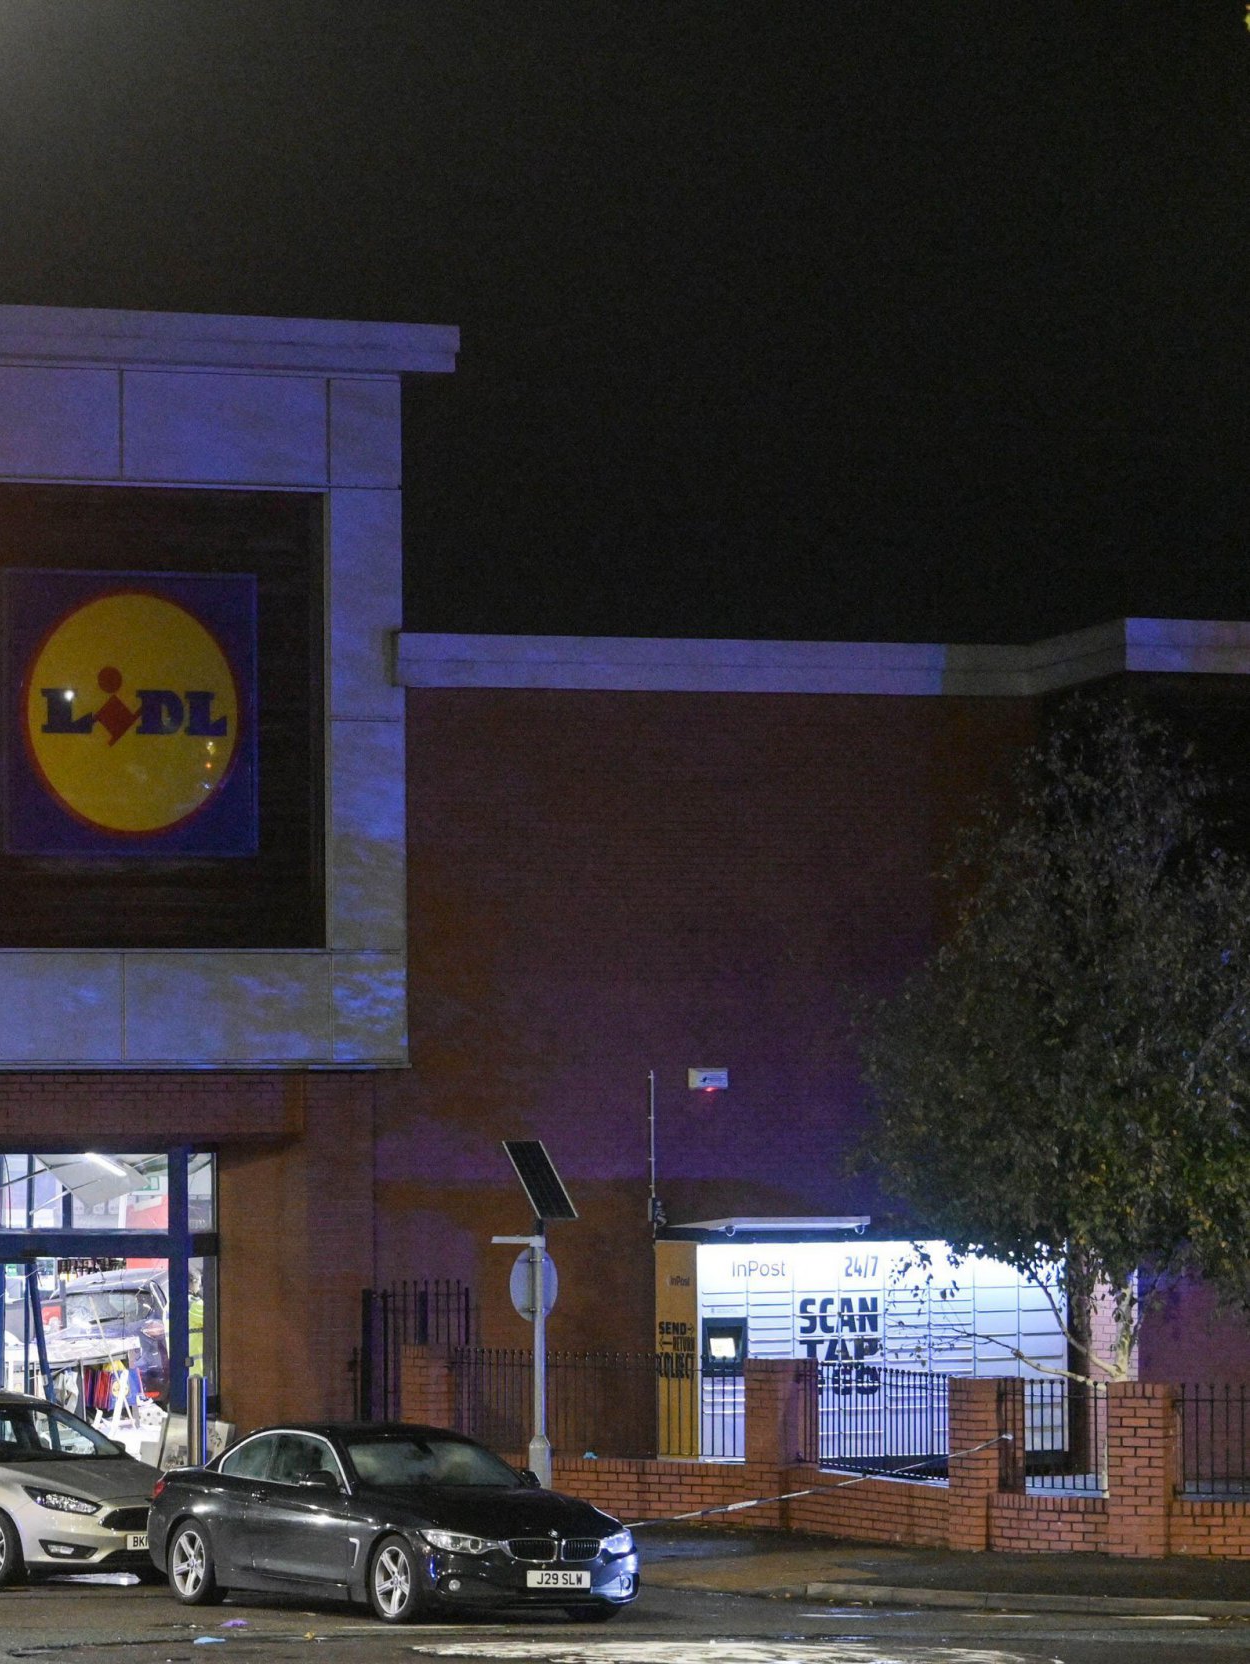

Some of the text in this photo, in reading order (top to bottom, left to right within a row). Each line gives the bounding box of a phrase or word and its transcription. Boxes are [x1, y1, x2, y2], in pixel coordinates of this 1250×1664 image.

[732, 1260, 786, 1277] InPost
[845, 1254, 879, 1278] 24/7
[799, 1297, 878, 1334] SCAN
[658, 1321, 687, 1335] SEND
[799, 1335, 881, 1370] TAP
[133, 1536, 148, 1547] BK1
[537, 1573, 583, 1585] J29 SLW
